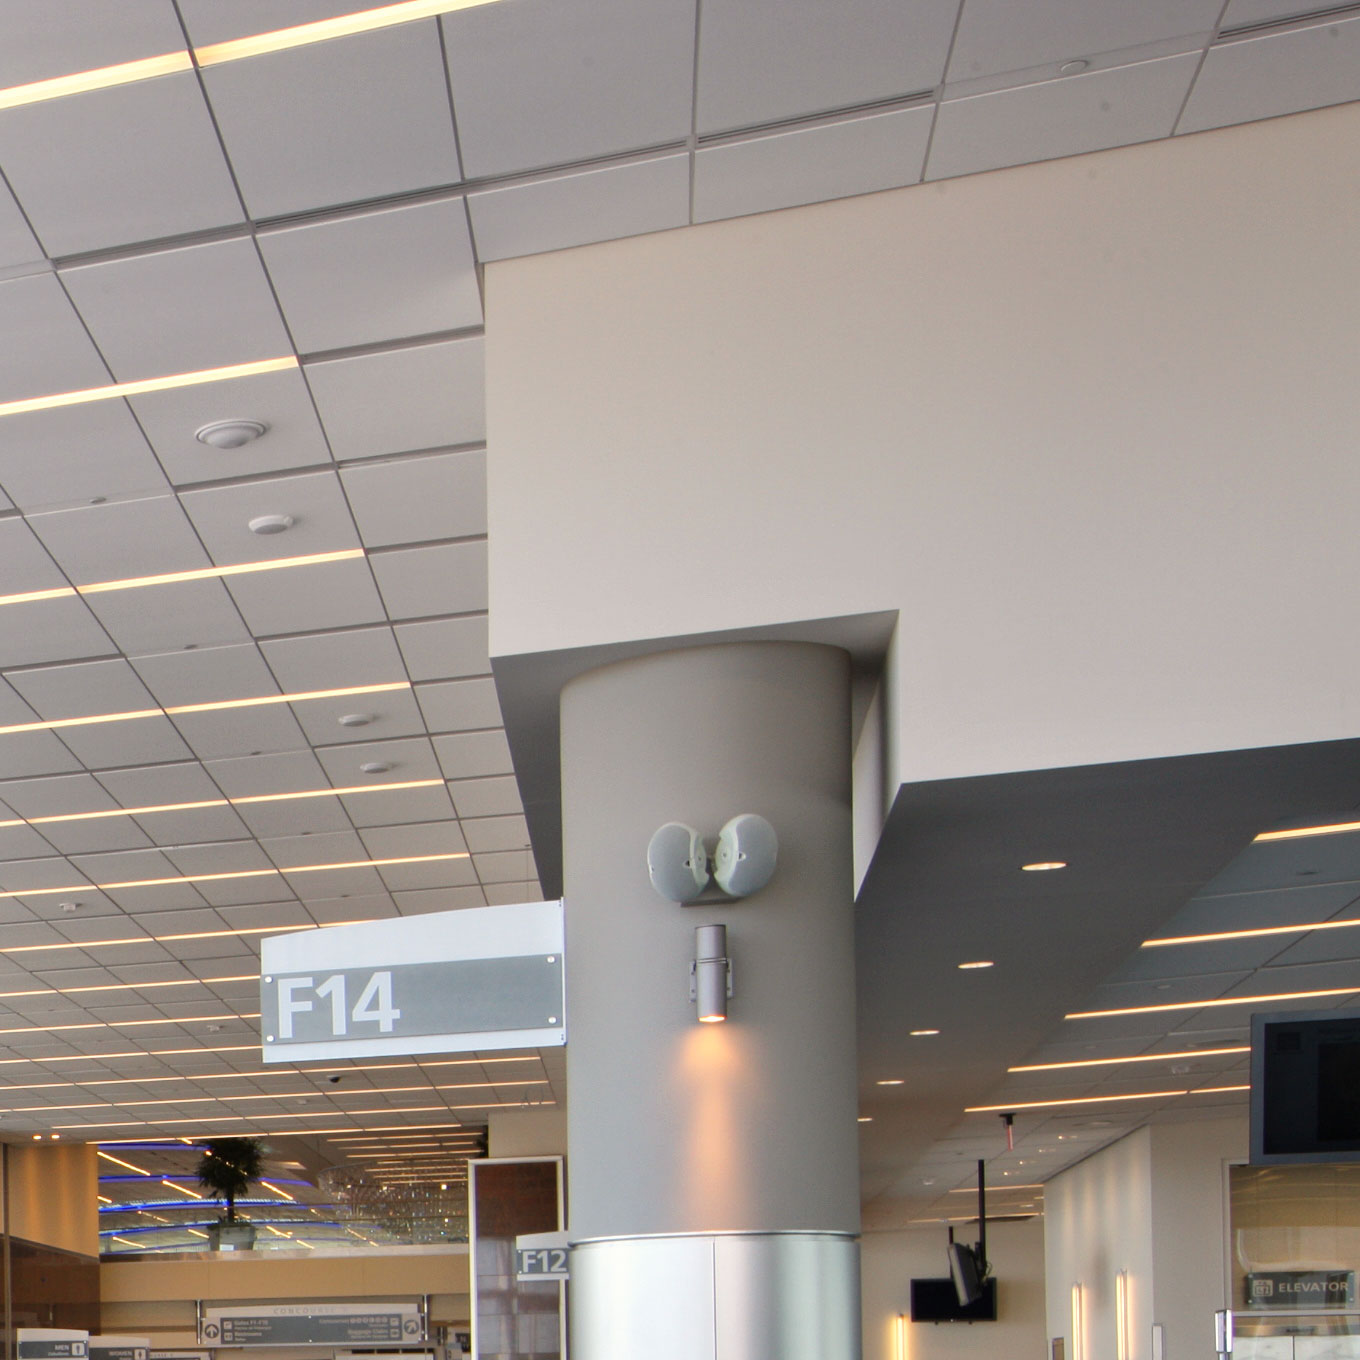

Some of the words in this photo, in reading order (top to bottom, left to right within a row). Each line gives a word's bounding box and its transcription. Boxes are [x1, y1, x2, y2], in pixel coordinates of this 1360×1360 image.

[277, 971, 401, 1039] F14
[521, 1250, 567, 1273] F12
[1278, 1281, 1349, 1293] ELEVATOR
